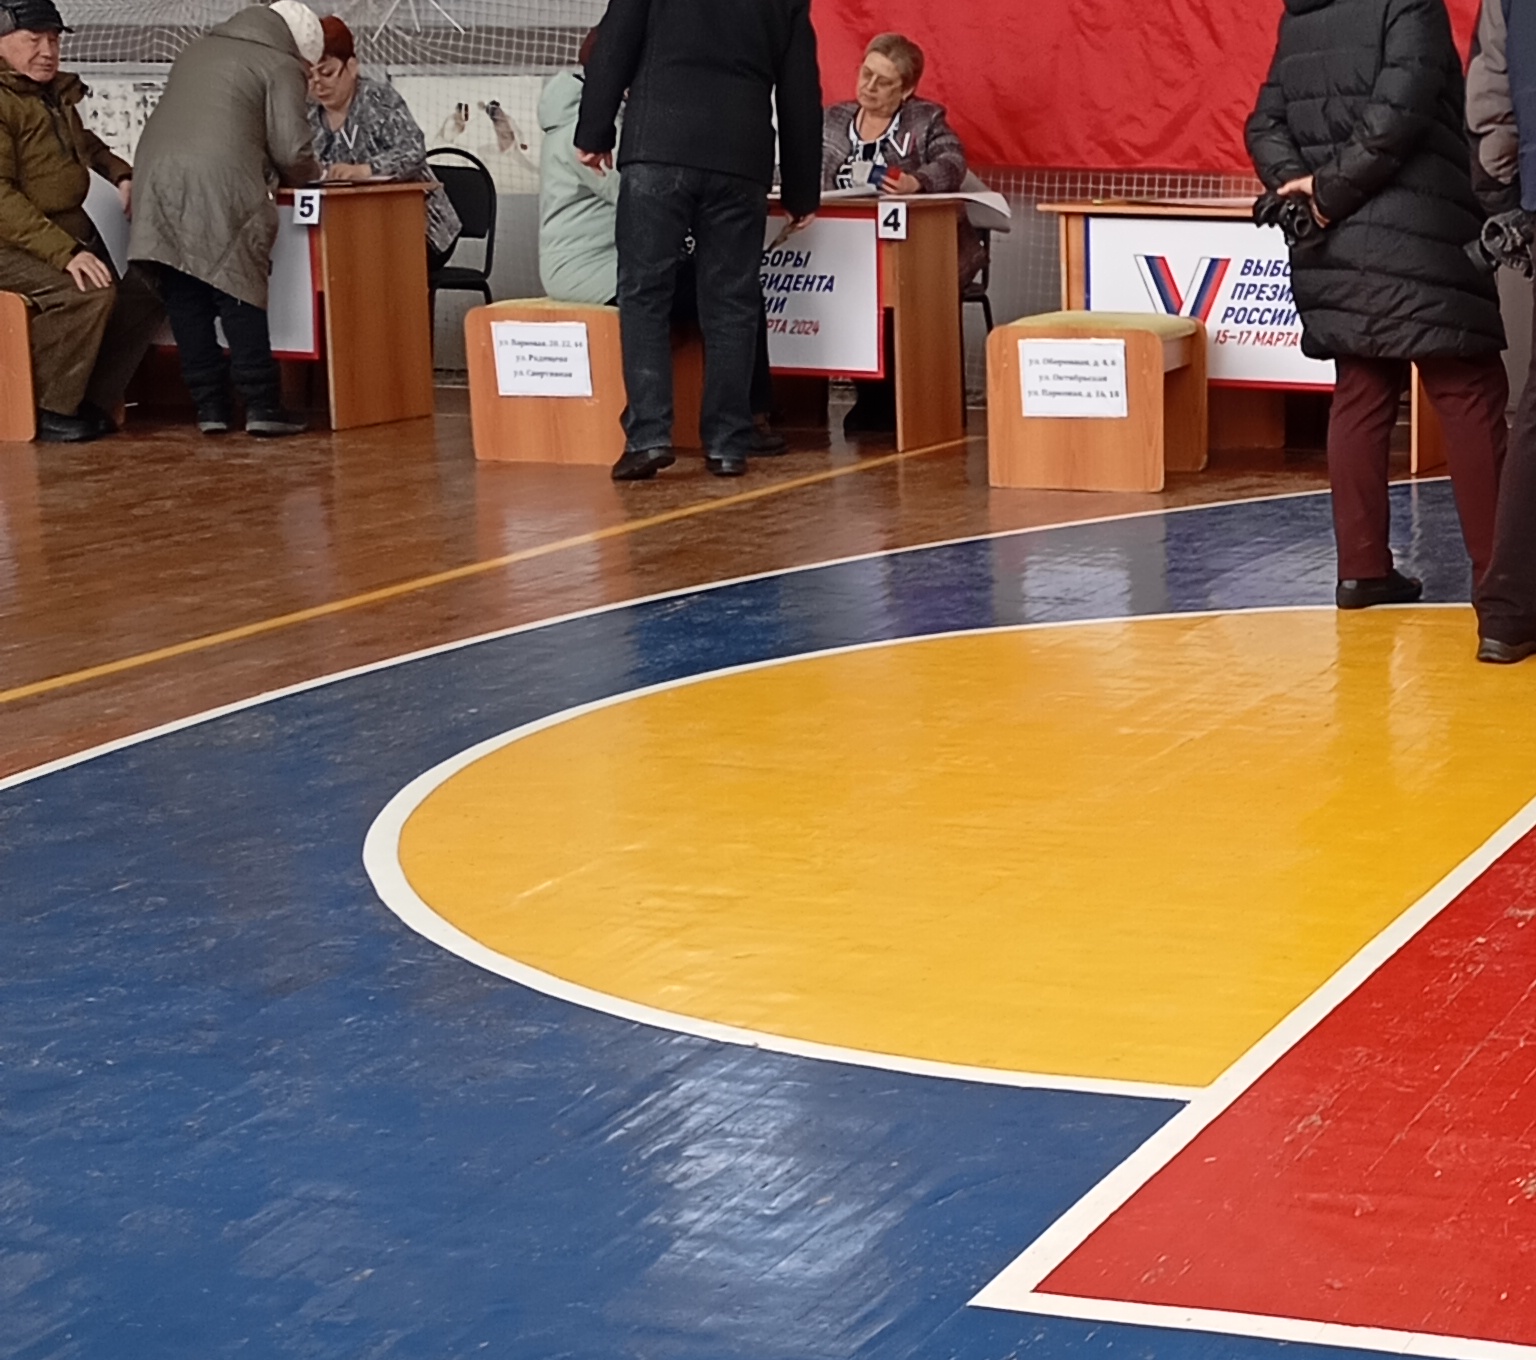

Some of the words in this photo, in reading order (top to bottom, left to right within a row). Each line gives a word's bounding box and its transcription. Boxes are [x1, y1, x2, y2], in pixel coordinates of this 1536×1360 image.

[299, 195, 314, 217] 5
[883, 207, 900, 231] 4
[761, 250, 811, 268] БОРЫ
[759, 273, 835, 293] ЗИДЕНТА
[1230, 283, 1294, 303] ПРЕЗИ
[1221, 307, 1299, 326] РОССИИ
[767, 319, 787, 334] РТА
[789, 320, 820, 335] 2024
[1252, 331, 1300, 347] МАРТА
